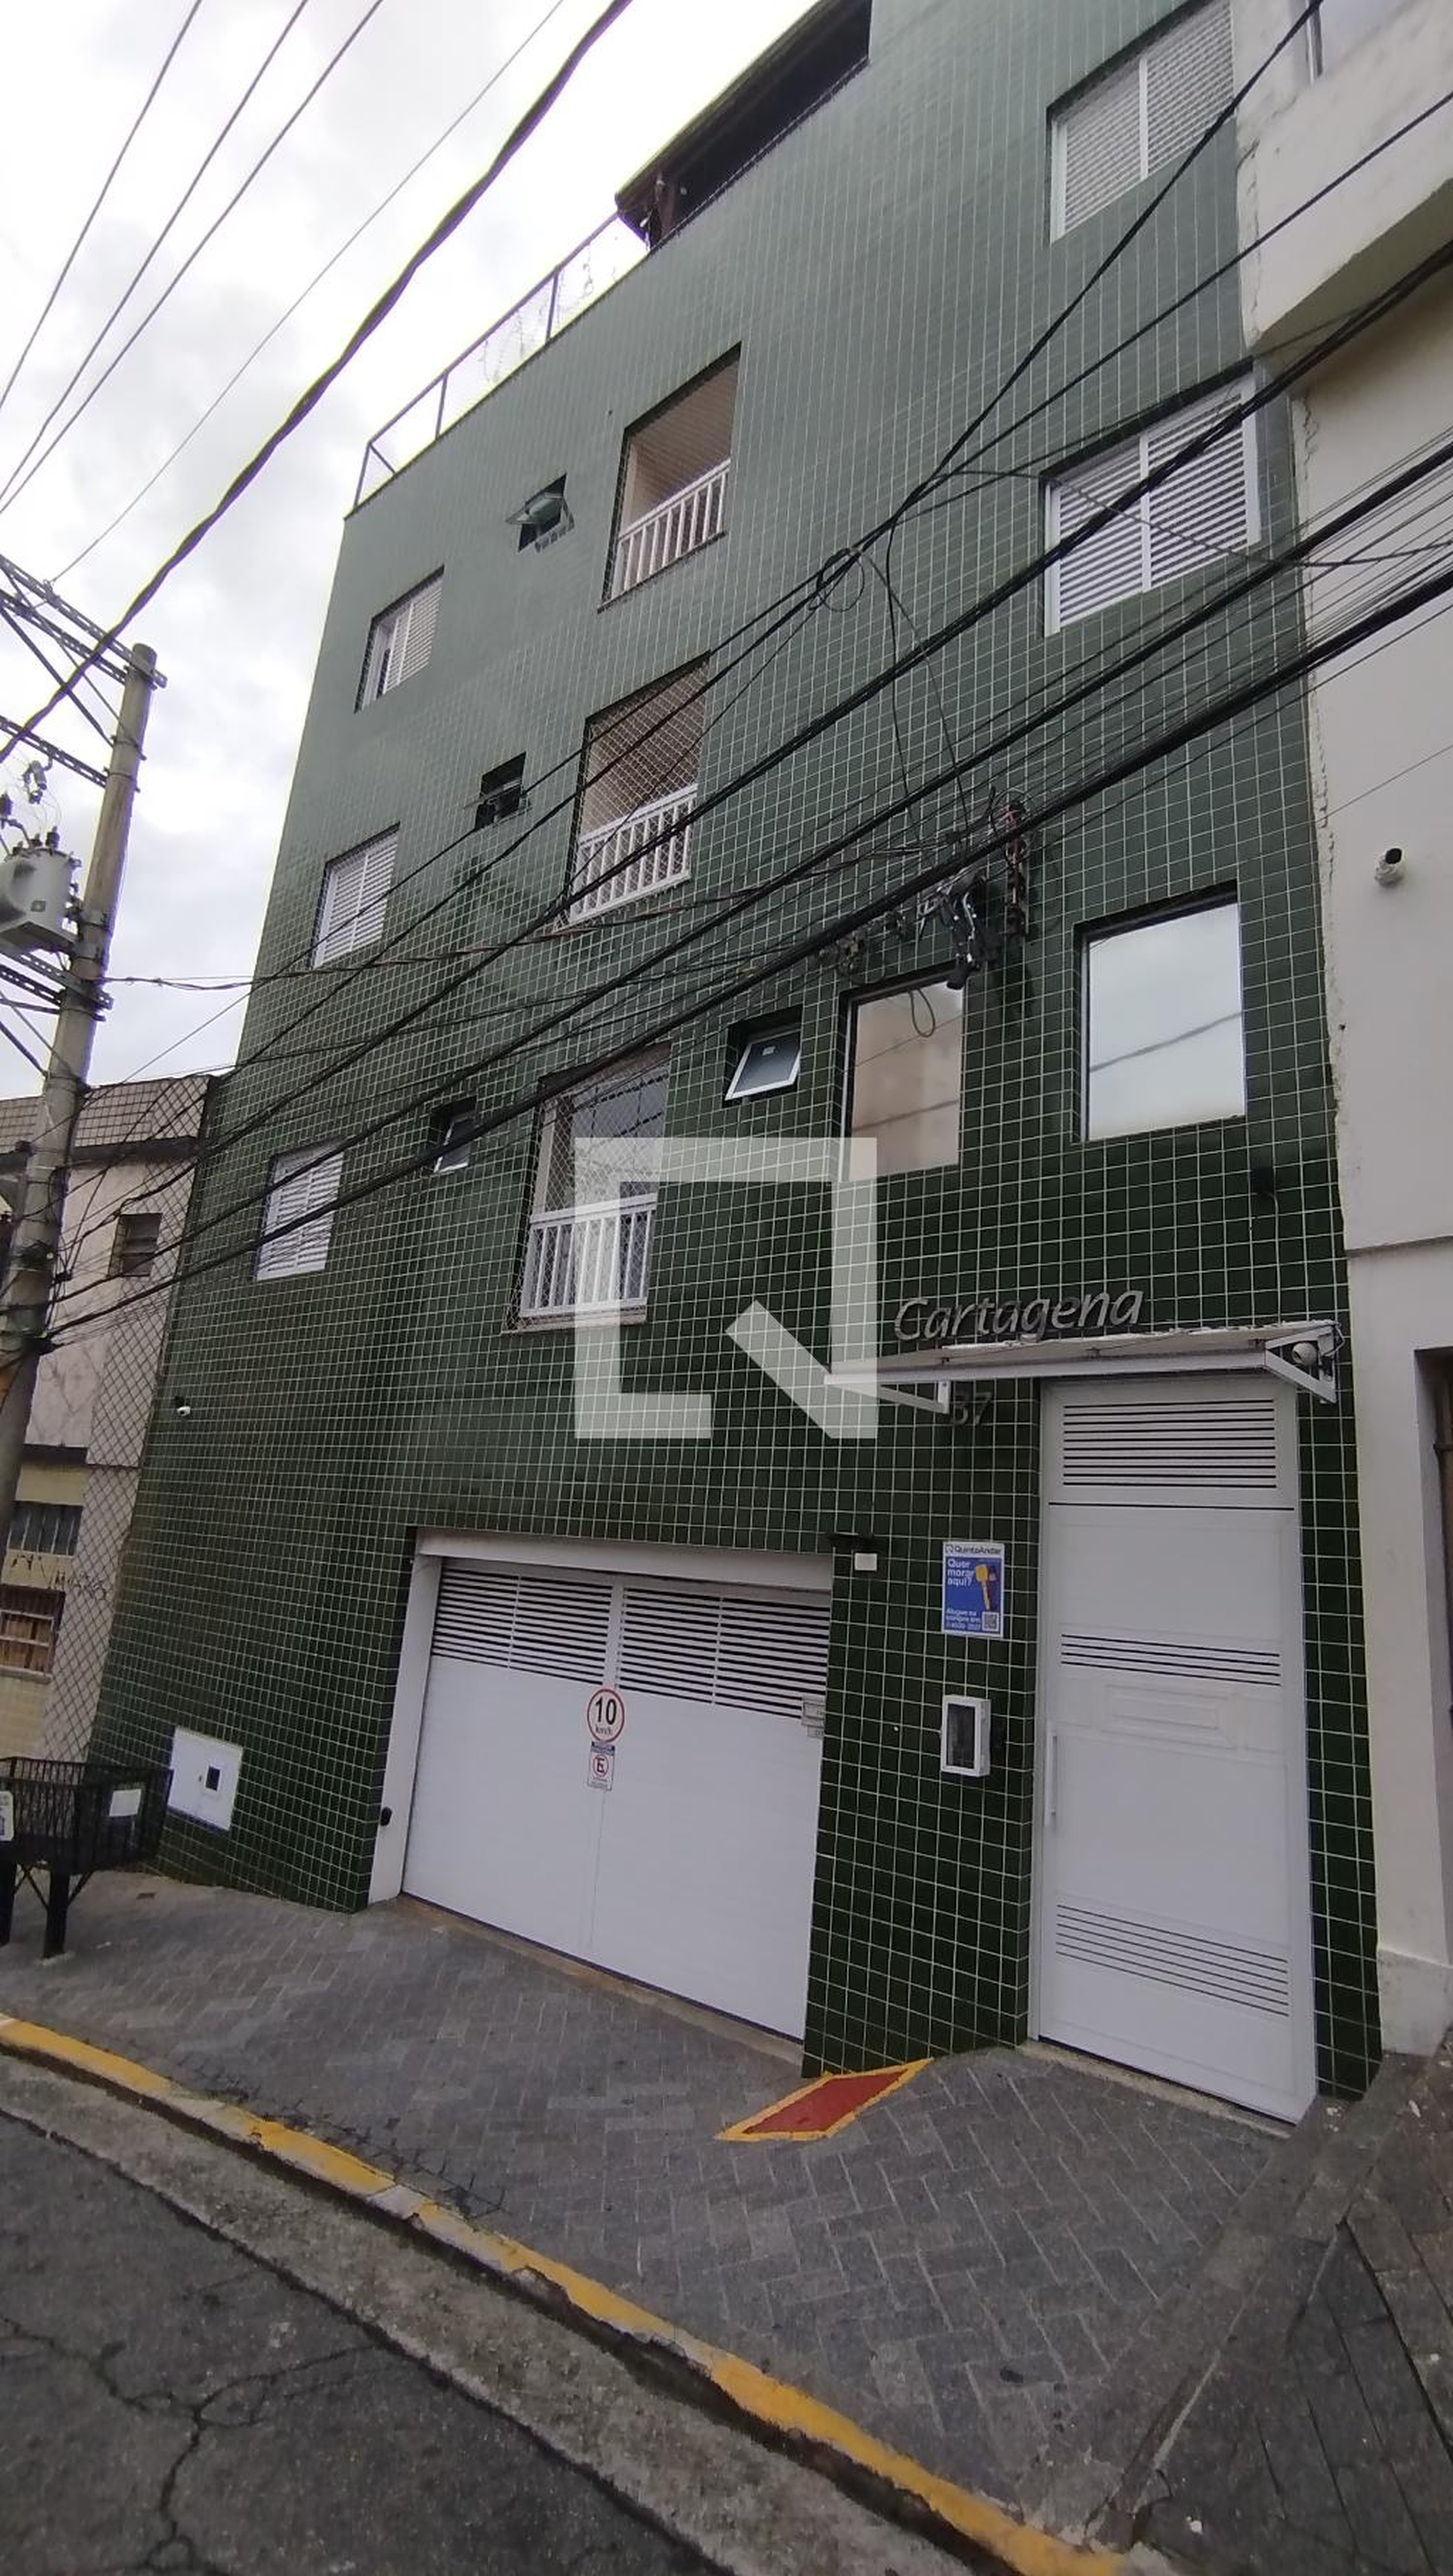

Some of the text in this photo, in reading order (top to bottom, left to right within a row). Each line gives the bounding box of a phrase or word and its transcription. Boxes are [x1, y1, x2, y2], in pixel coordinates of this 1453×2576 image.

[894, 1290, 1143, 1342] Cartagena
[947, 1569, 974, 1577] morar
[595, 1697, 617, 1725] 10
